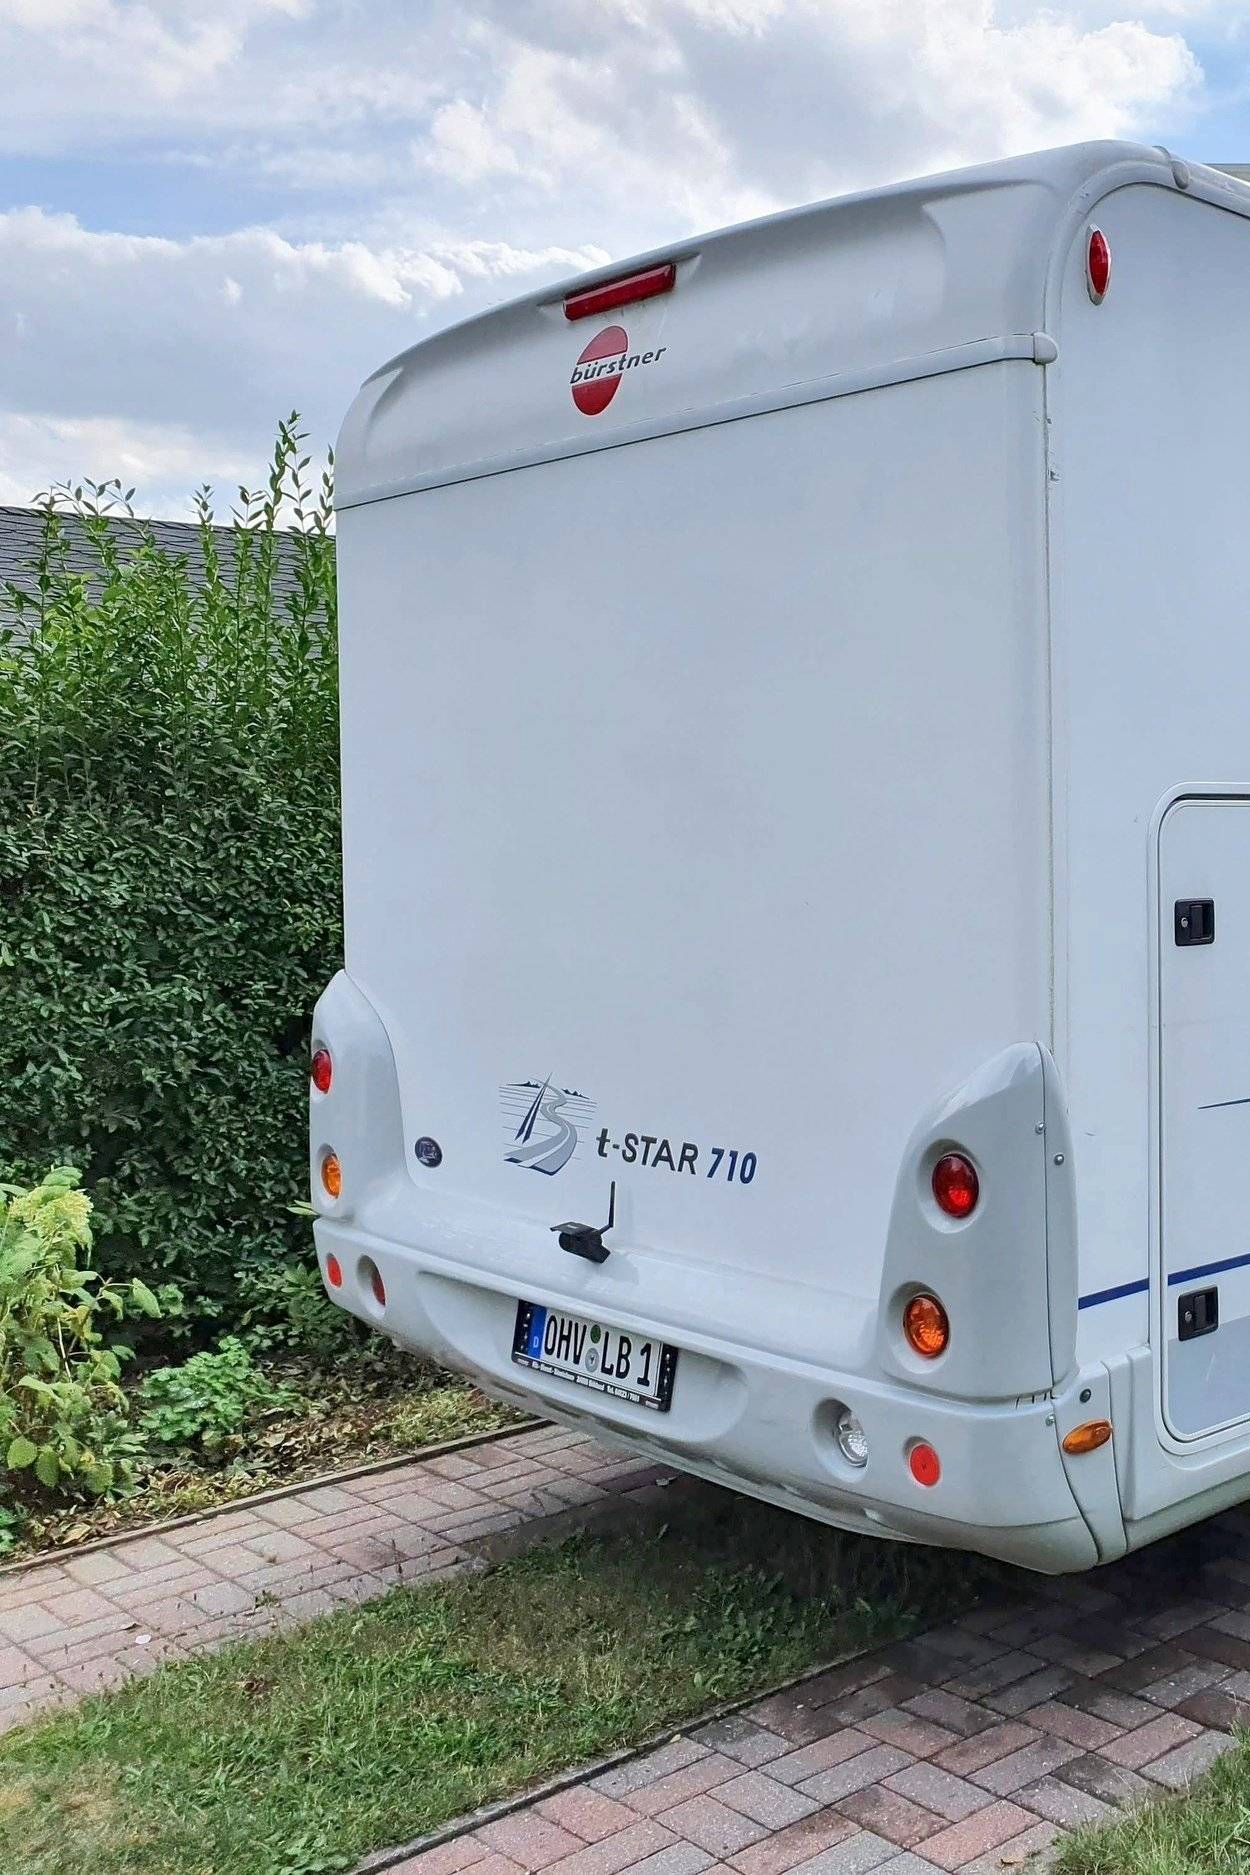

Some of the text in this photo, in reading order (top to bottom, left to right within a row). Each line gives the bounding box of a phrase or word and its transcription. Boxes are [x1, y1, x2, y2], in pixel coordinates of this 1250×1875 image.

[570, 347, 667, 384] bürstner
[596, 1128, 757, 1184] t-STAR 710
[533, 1336, 540, 1349] D
[544, 1315, 651, 1387] OHV LB 1
